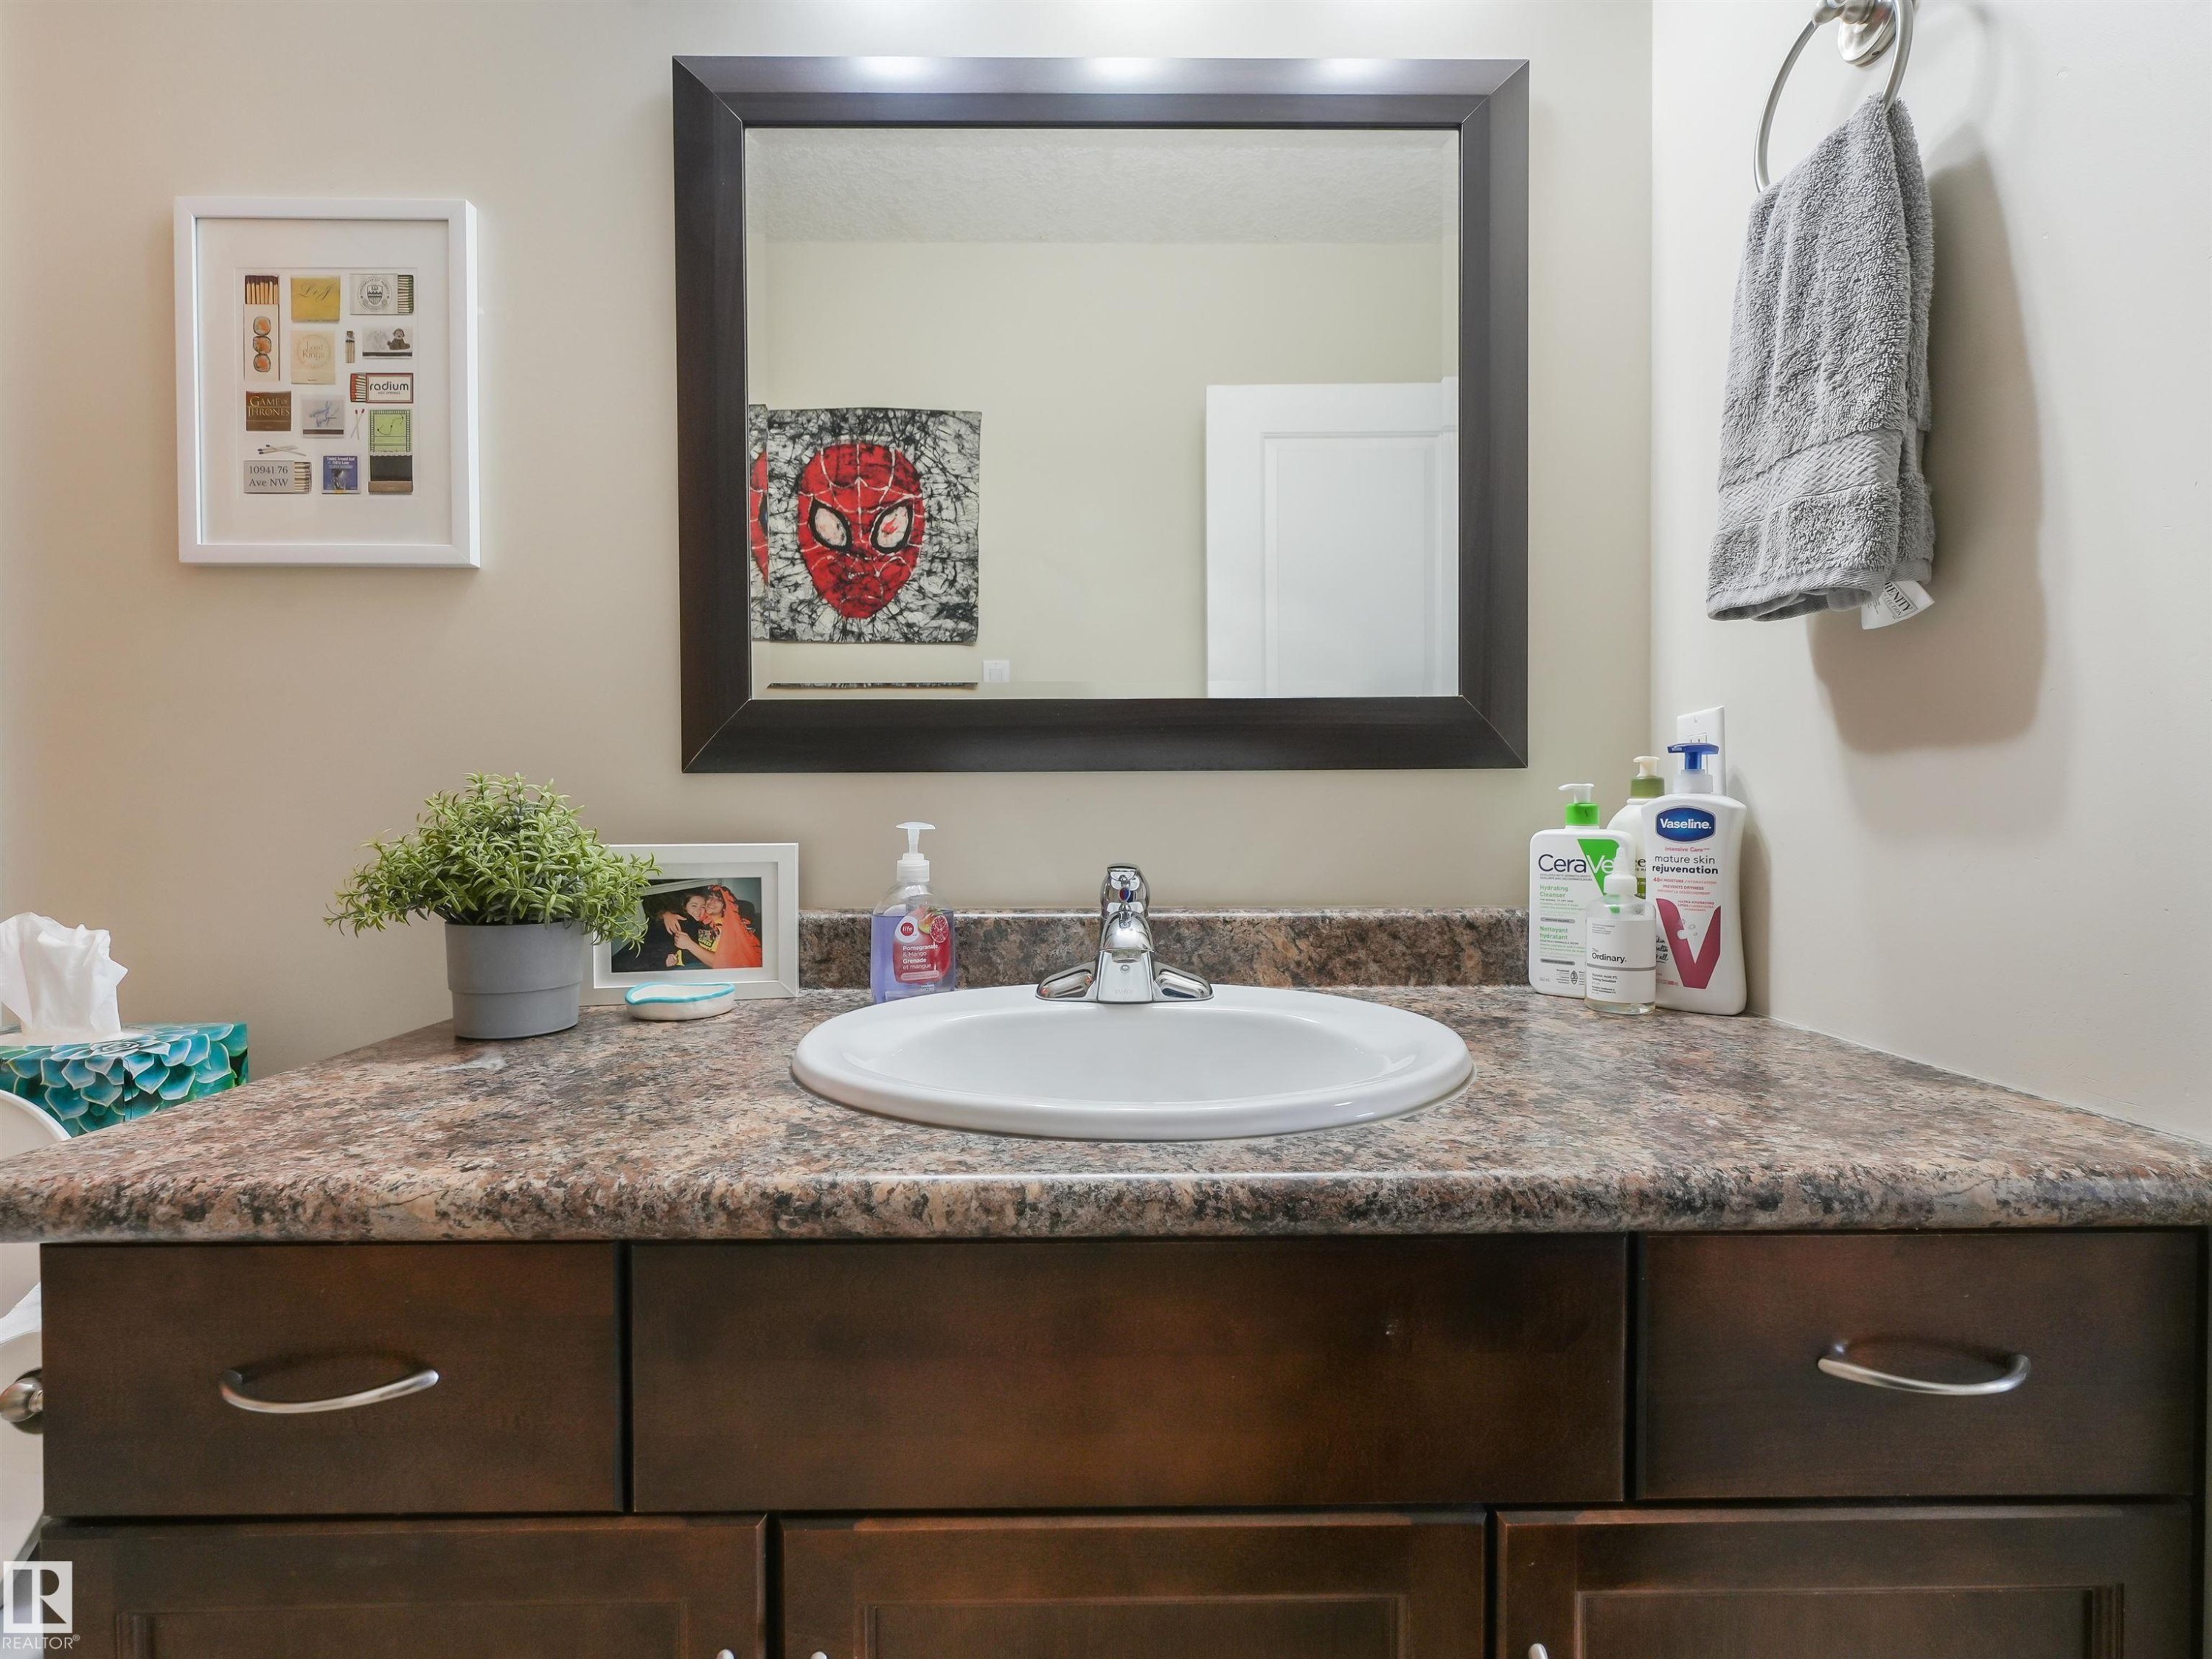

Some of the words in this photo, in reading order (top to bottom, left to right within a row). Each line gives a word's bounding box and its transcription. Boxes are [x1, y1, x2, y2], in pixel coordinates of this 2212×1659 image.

[369, 381, 408, 391] radium
[248, 406, 290, 417] THRONES
[249, 465, 275, 474] 10941
[276, 465, 288, 474] 76
[248, 479, 267, 487] Ave
[269, 479, 288, 487] NW
[1885, 582, 1914, 611] RENITY
[1660, 818, 1711, 830] Vaseline.
[1538, 854, 1614, 874] CeraVe
[1655, 855, 1690, 863] mature
[1693, 855, 1715, 864] skin
[1652, 864, 1718, 874] rejuvenation
[1592, 952, 1627, 964] Ordinary.
